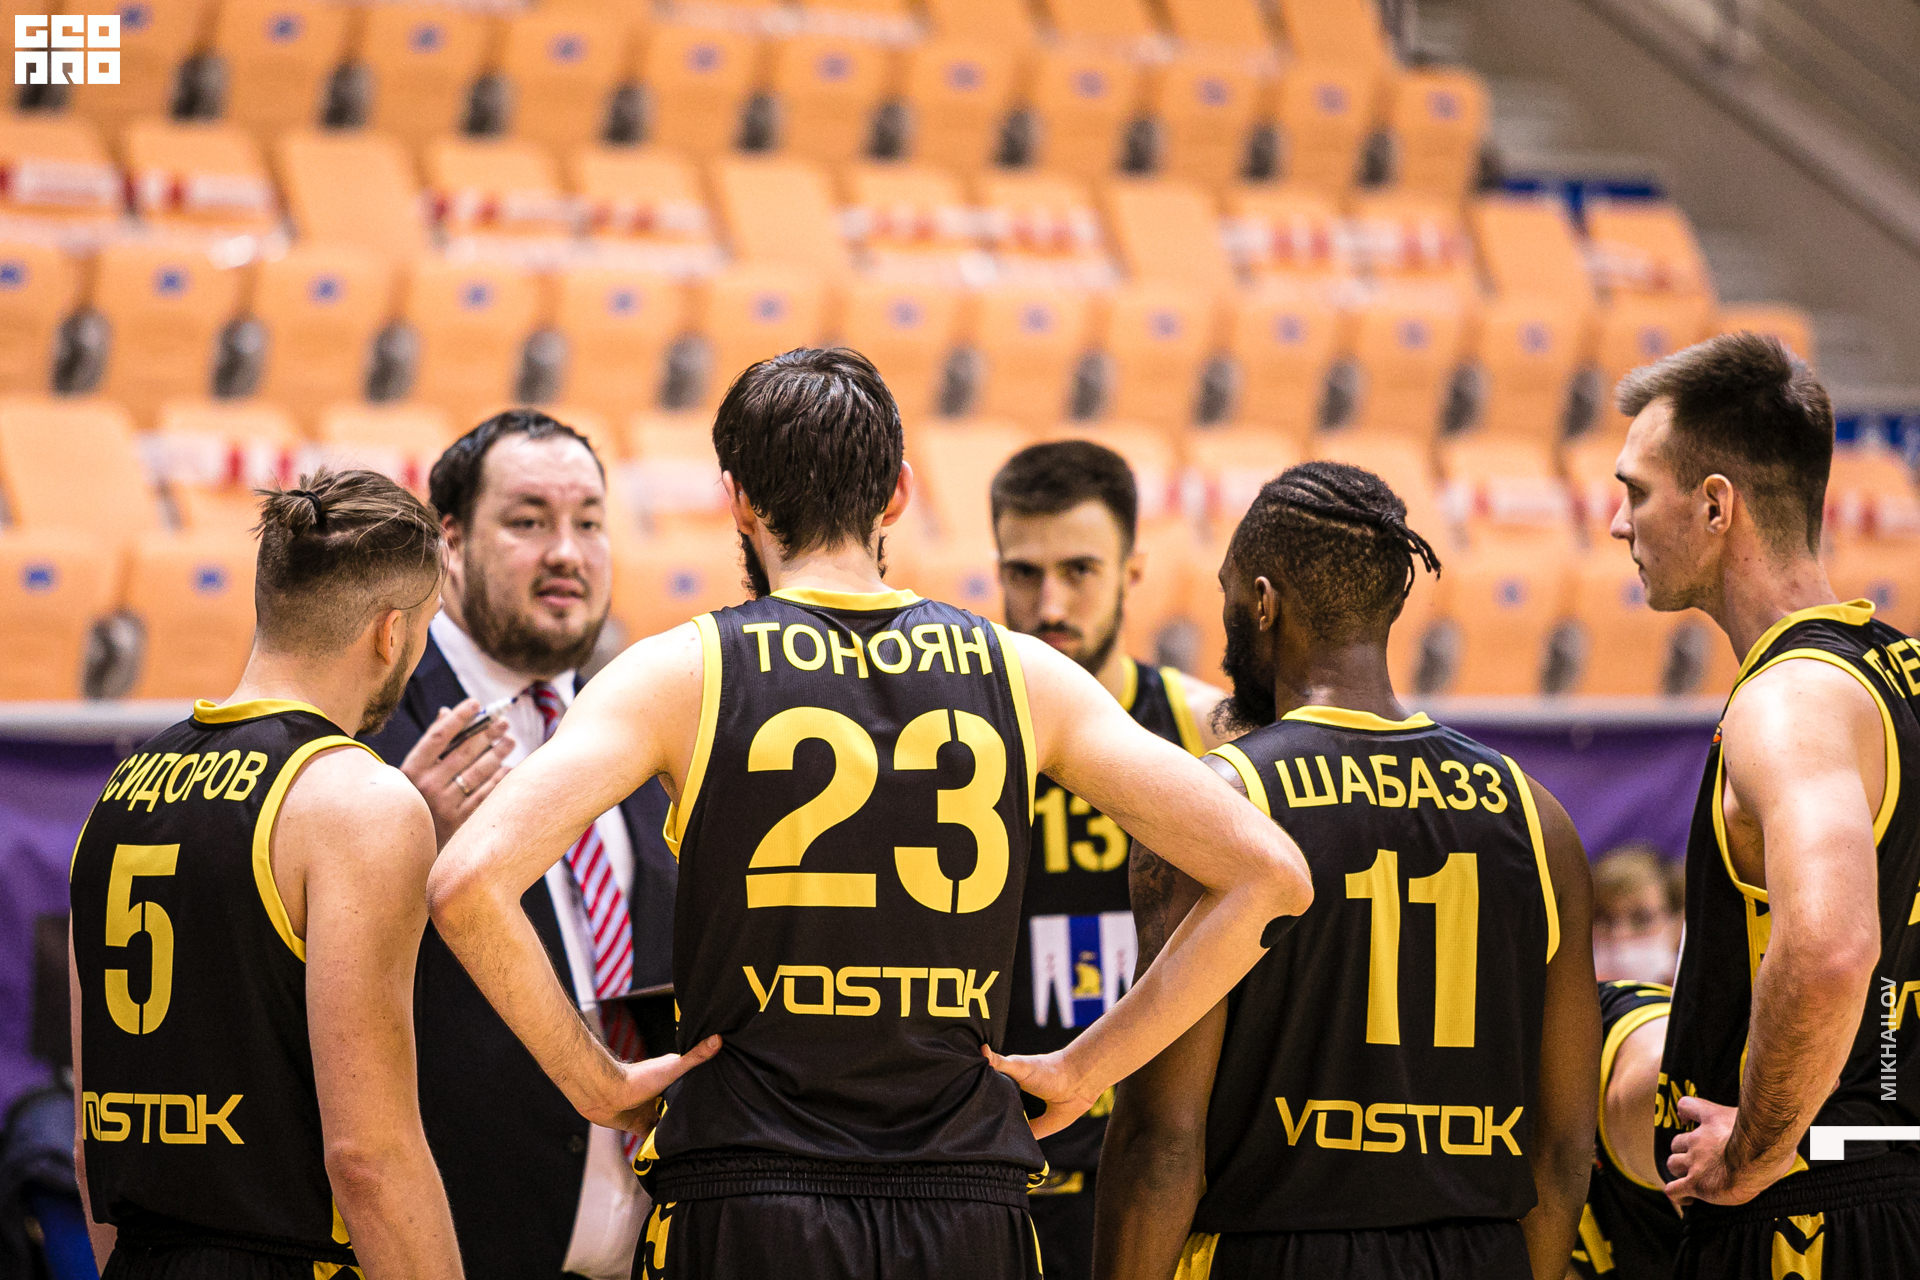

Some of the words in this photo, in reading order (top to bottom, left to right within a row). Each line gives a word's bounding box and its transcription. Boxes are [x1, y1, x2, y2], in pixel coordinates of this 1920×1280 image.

[742, 622, 993, 679] ТОНОЯН
[102, 749, 269, 813] СИДОРОВ
[746, 707, 1010, 914] 23
[1275, 754, 1508, 814] ШАБАЗЗ
[1033, 786, 1129, 873] 13
[104, 843, 181, 1035] 5
[1345, 849, 1479, 1048] 11
[743, 964, 1000, 1020] VOSTOK
[82, 1091, 245, 1145] OSTOK
[1275, 1096, 1524, 1156] VOSTOK
